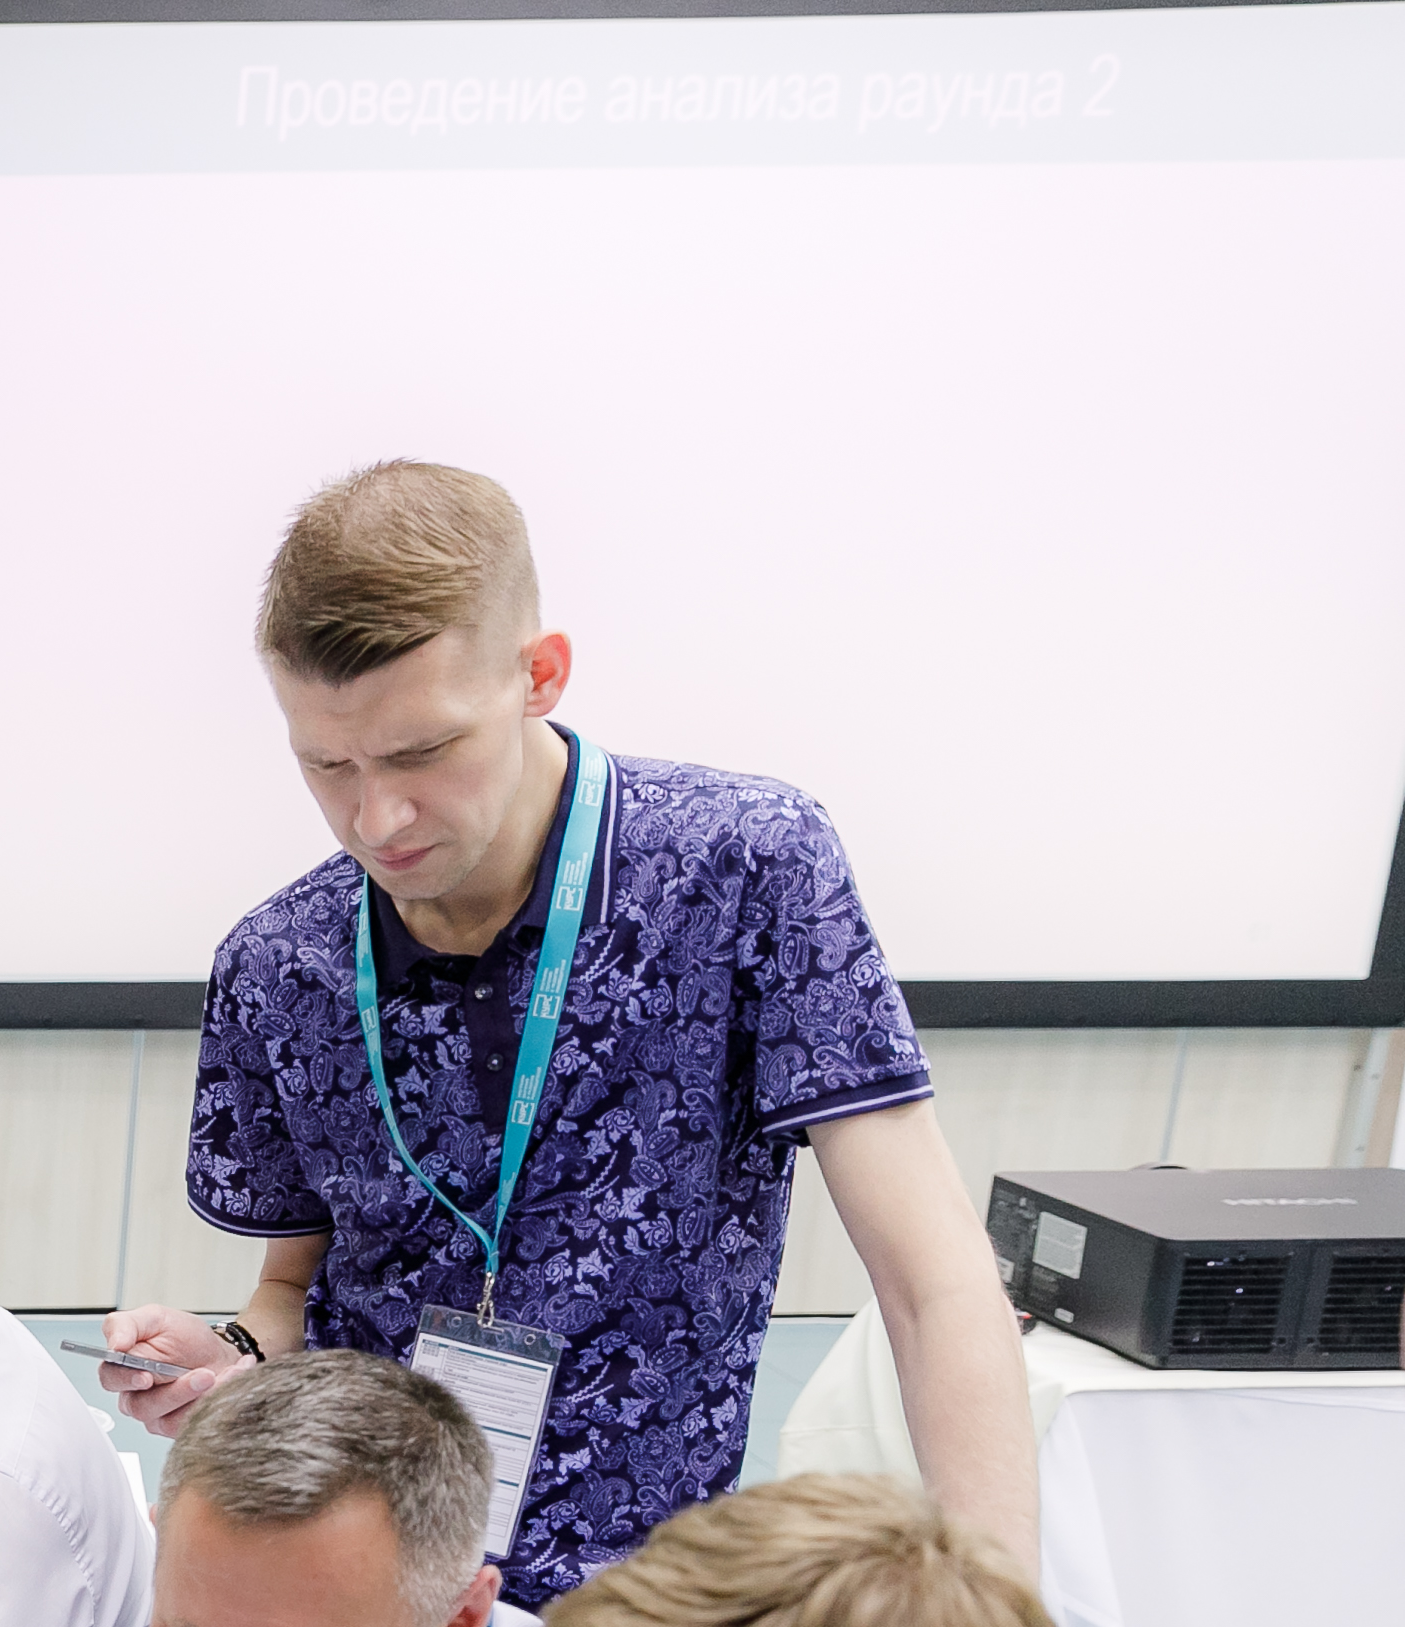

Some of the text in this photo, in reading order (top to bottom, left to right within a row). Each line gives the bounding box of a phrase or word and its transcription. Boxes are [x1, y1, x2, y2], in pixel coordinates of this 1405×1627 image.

[236, 52, 1122, 142] Проведение анализа раунда 2
